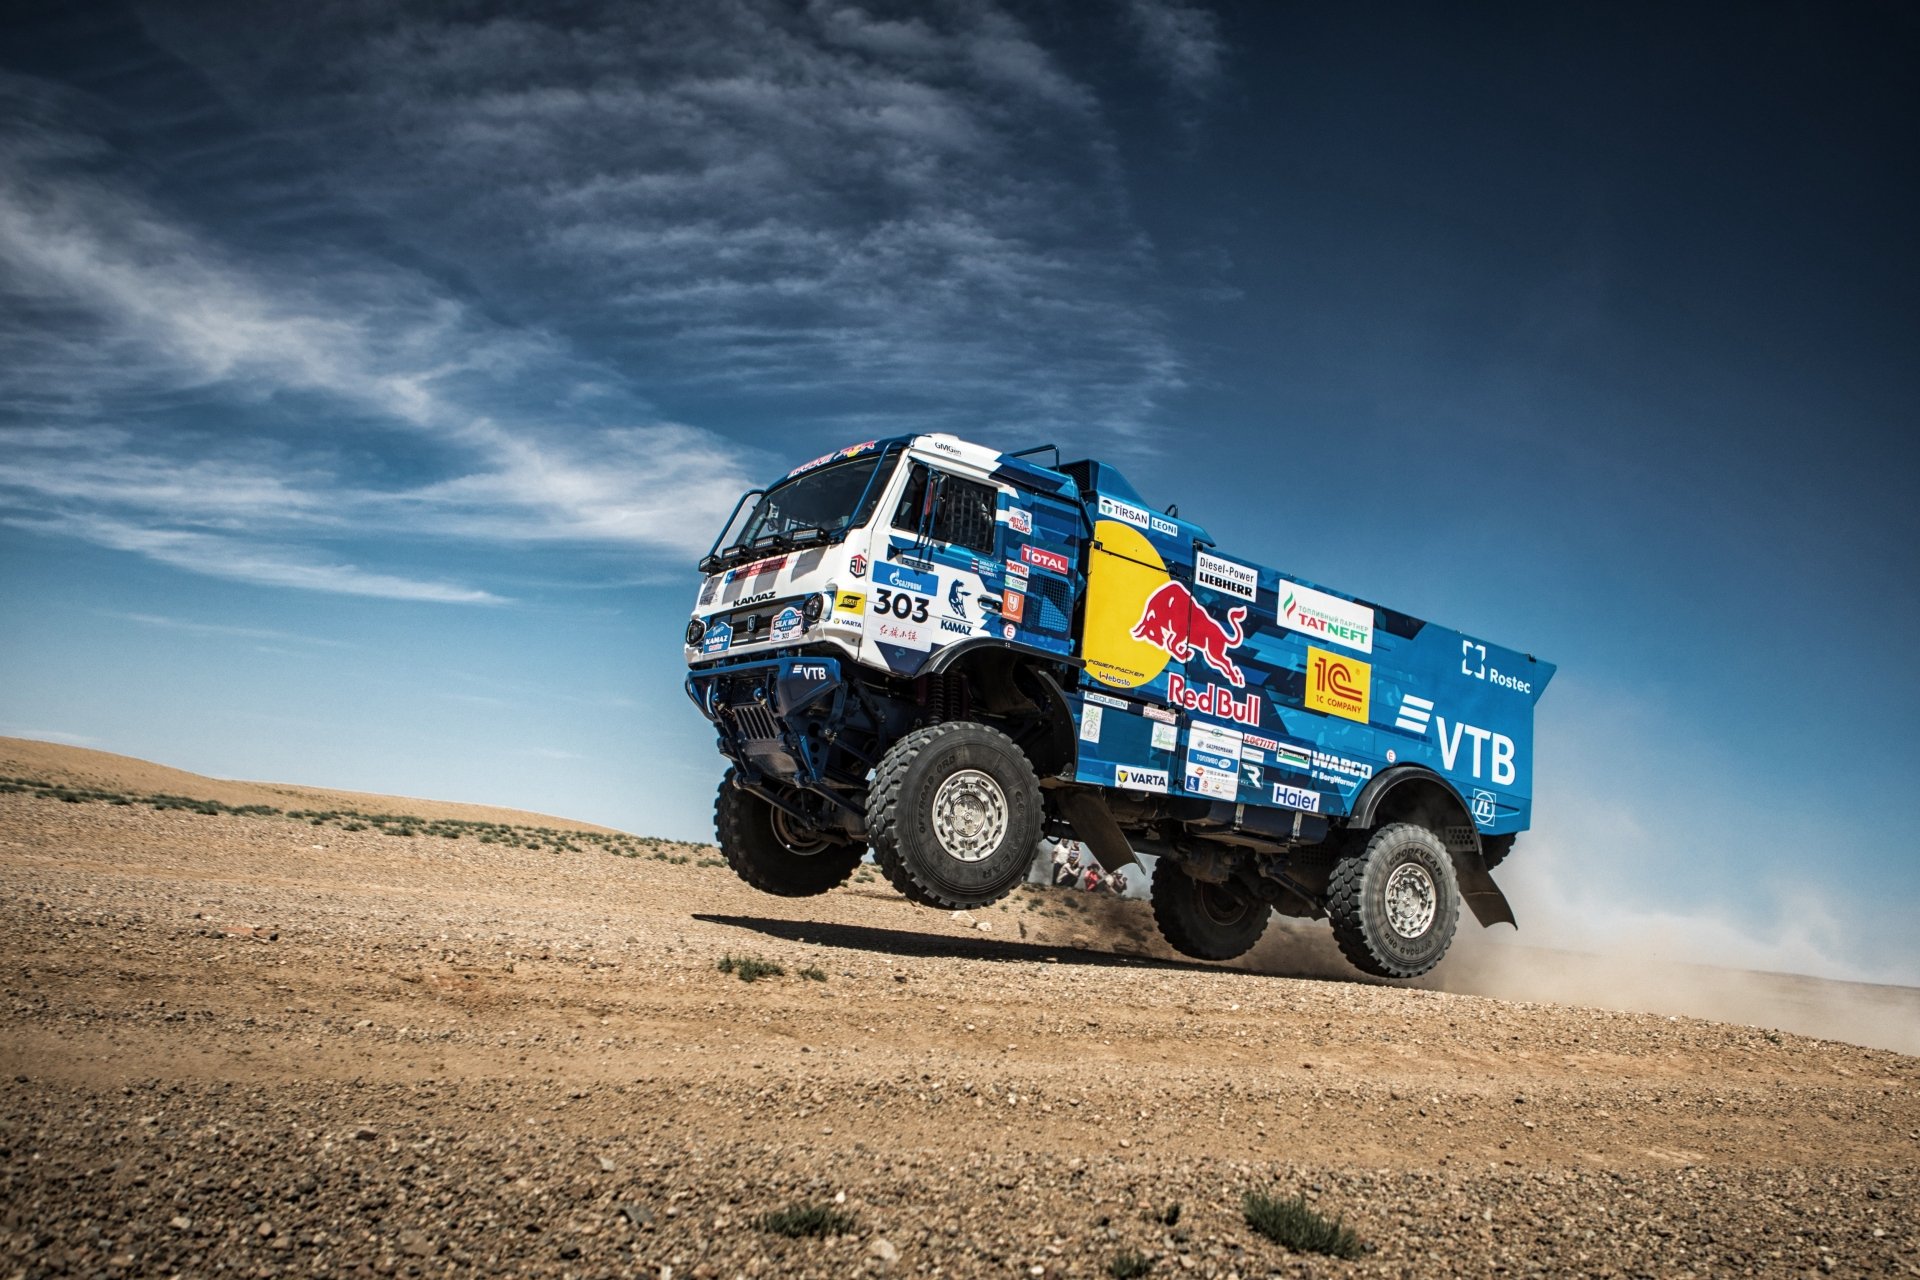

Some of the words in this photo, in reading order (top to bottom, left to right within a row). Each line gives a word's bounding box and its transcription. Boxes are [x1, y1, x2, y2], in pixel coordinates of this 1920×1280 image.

[1114, 504, 1148, 525] TİRSAN
[1152, 519, 1177, 534] LEONI
[1023, 547, 1065, 571] TOTAL
[1200, 557, 1254, 583] Diesel-Power
[1199, 572, 1252, 597] LIEBHERR
[733, 591, 776, 607] KAMAZ
[873, 588, 929, 623] 303
[841, 619, 861, 628] VARTA
[940, 620, 972, 636] KAMAZ
[1298, 613, 1367, 644] TATNEFT
[1299, 605, 1338, 623] ТОПЛИВНЫЙ
[1340, 618, 1368, 632] ПАРТНЕР
[705, 635, 728, 645] KAMAZ
[1006, 627, 1013, 637] E
[803, 666, 826, 680] VTB
[1099, 671, 1130, 687] Webasto
[1490, 668, 1531, 694] Rostec
[1168, 672, 1215, 714] Red
[1216, 687, 1261, 726] Bull
[1316, 694, 1324, 704] 1C
[1327, 698, 1362, 713] COMPANY
[1245, 735, 1277, 750] LOCTITE
[1436, 715, 1515, 786] VTB
[1312, 750, 1372, 779] WABCO
[1388, 752, 1394, 761] E
[1131, 772, 1166, 787] VARTA
[1319, 771, 1357, 787] BorgWarner
[1276, 786, 1316, 810] Haier
[982, 791, 1026, 878] GOEAR
